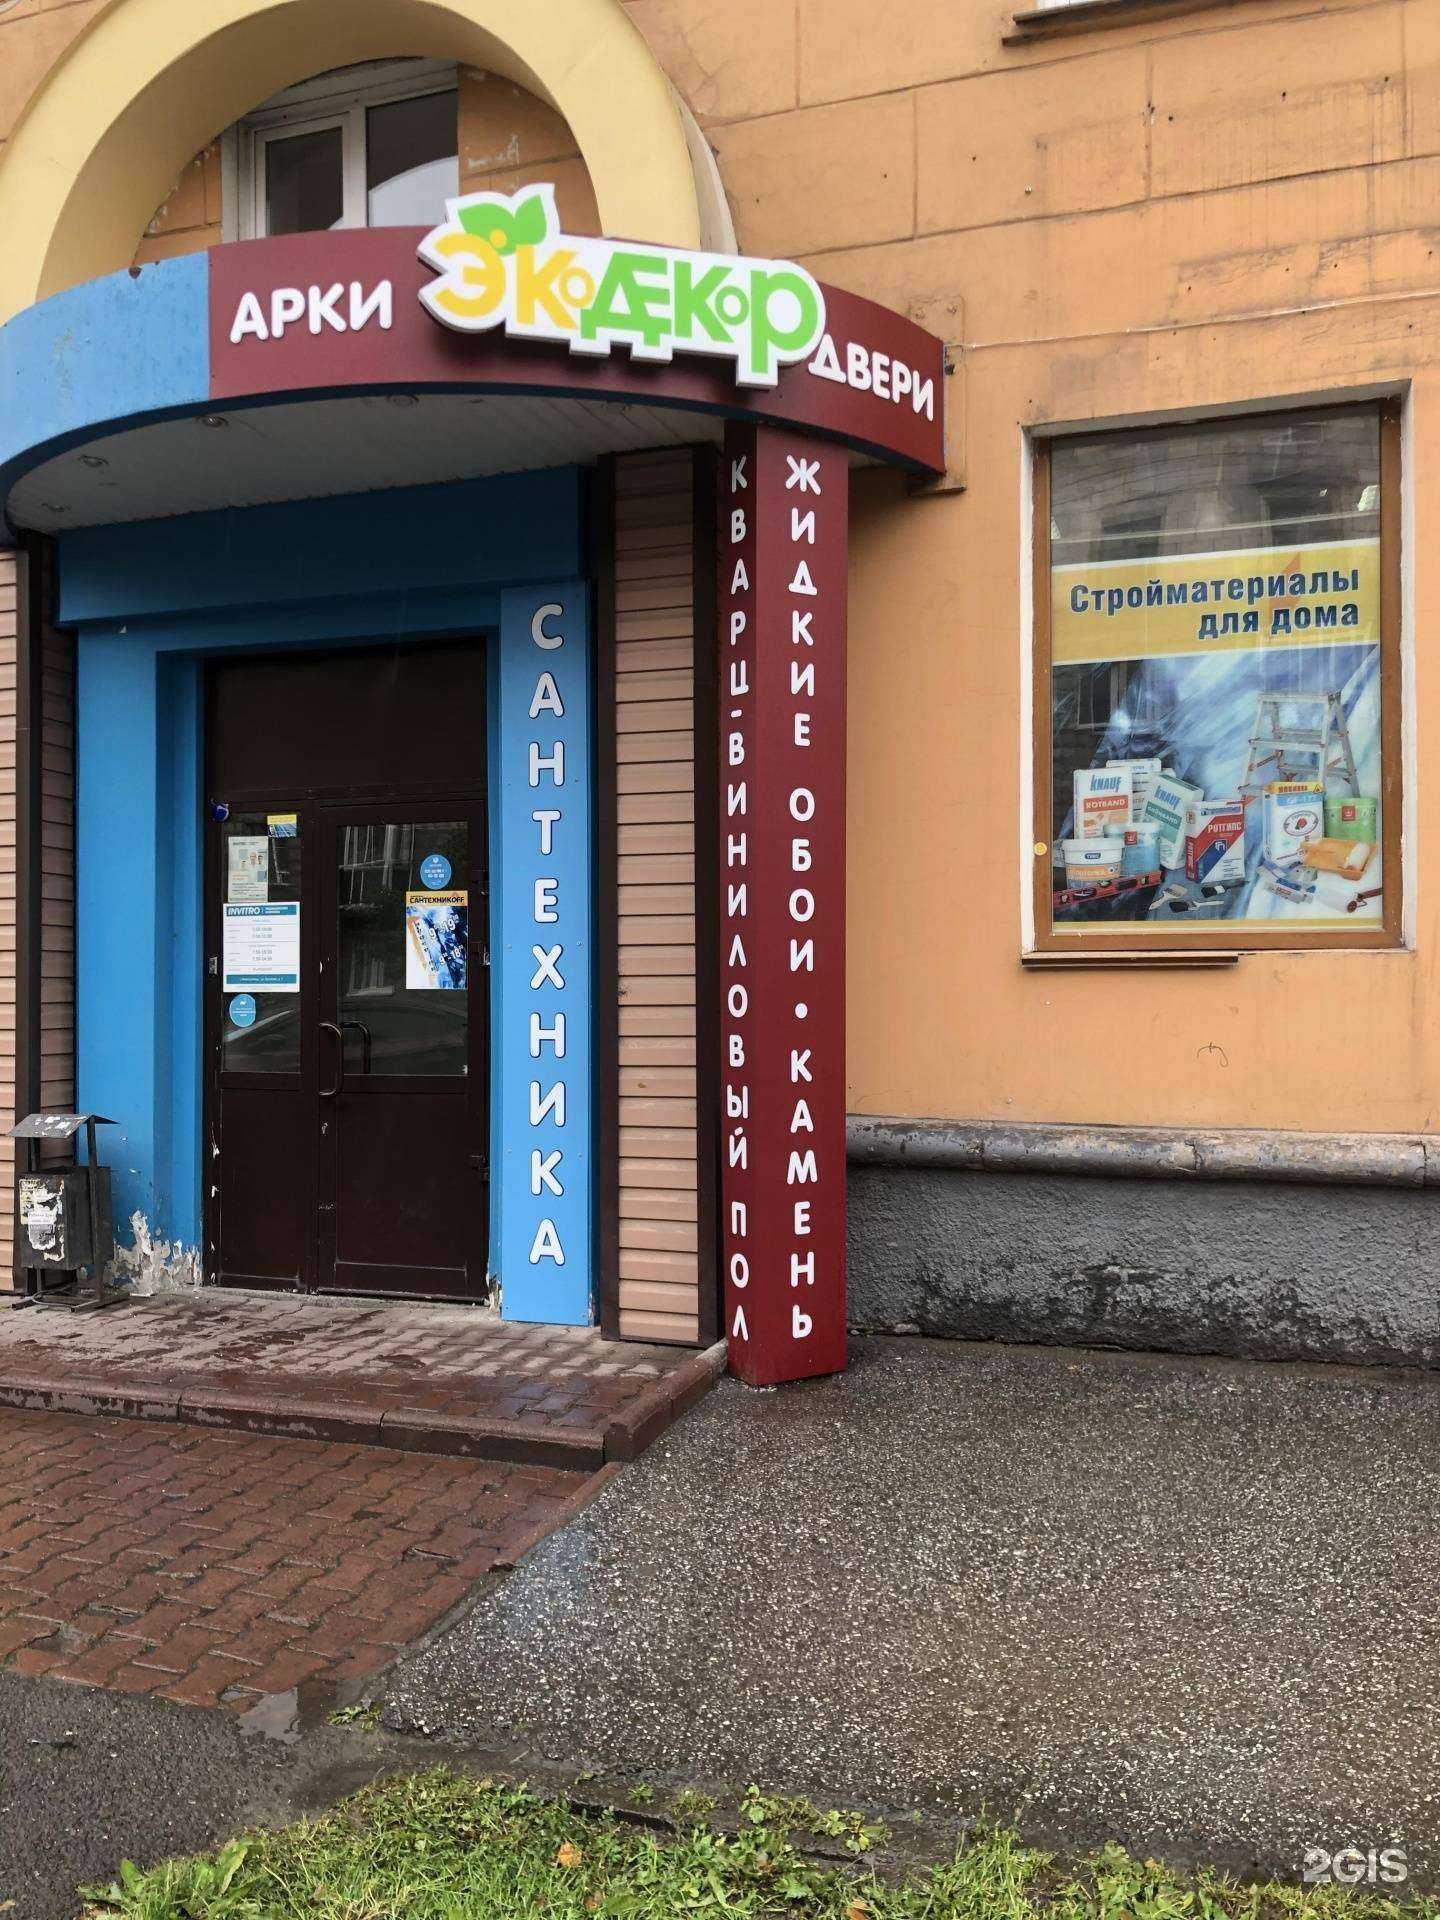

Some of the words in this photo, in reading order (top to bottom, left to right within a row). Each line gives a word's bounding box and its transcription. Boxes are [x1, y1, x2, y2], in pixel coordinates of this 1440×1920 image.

[229, 280, 393, 344] АРКИ
[807, 334, 935, 421] ДВЕРИ
[785, 455, 822, 747] ЖИДКИЕ
[1069, 568, 1359, 616] Стройматериалы
[1198, 610, 1259, 640] для
[1270, 603, 1359, 636] дома
[726, 455, 749, 1170] КВАРЦ-ВИНИЛОВЫЙ
[788, 787, 815, 972] ОБОИ
[228, 907, 260, 915] INVITRO
[529, 604, 566, 1266] САНТЕХНИКА
[786, 1049, 818, 1339] КАМЕНЬ
[730, 1201, 749, 1341] ПОЛ
